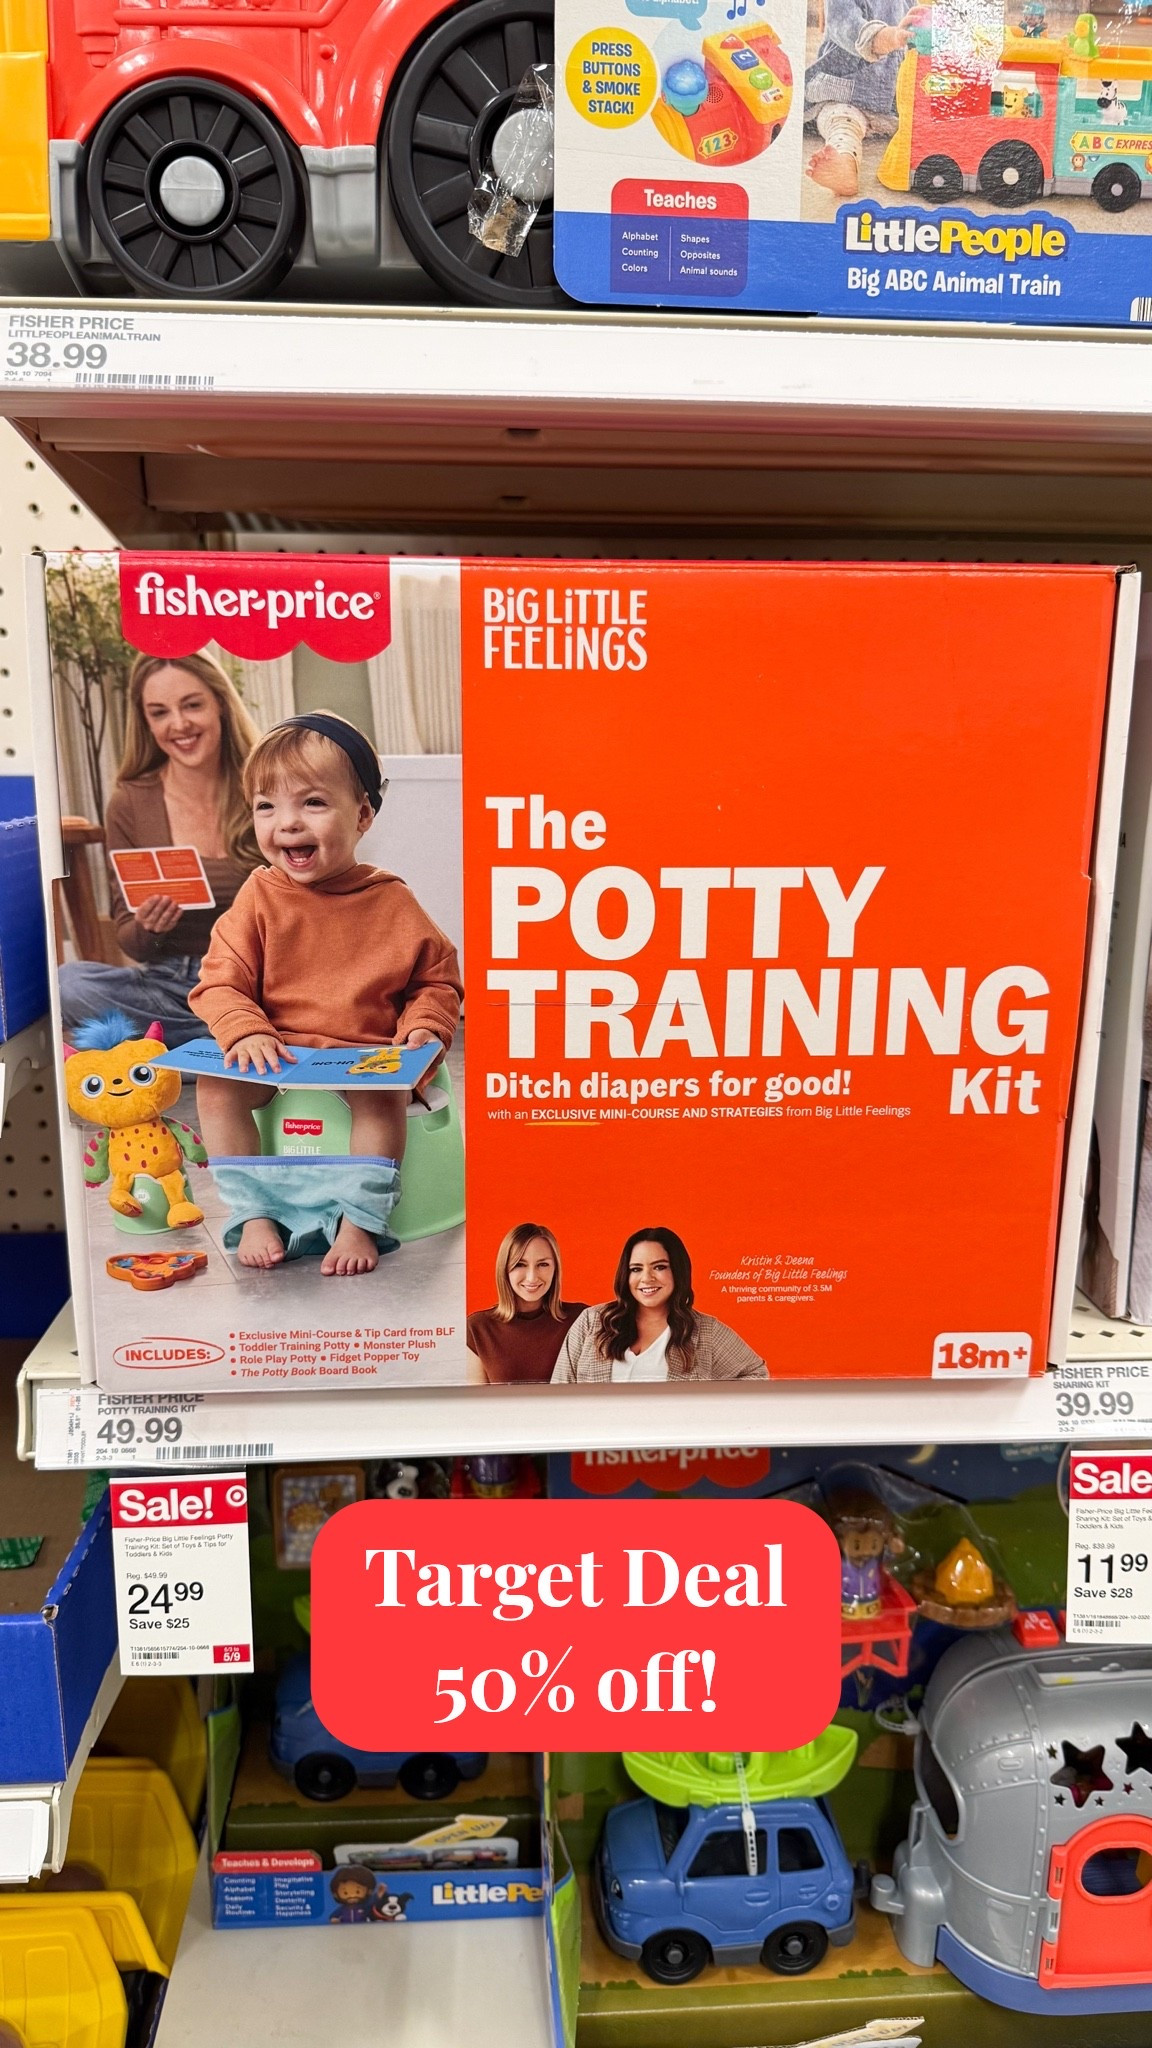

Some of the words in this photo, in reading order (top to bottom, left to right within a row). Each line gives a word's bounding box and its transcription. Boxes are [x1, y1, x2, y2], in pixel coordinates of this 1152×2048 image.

[592, 42, 632, 56] PRESS
[583, 61, 640, 76] BUTTONS
[583, 81, 592, 92] &
[596, 81, 640, 95] SMOKE
[589, 101, 634, 114] STACK!
[644, 189, 717, 209] Teaches
[622, 232, 658, 241] Alphabet
[681, 234, 709, 244] Shapes
[622, 248, 658, 258] Counting
[680, 250, 720, 261] Opposites
[622, 264, 648, 272] Colors
[680, 266, 707, 275] Animal
[710, 267, 737, 276] sounds
[847, 267, 880, 297] Big
[885, 269, 927, 291] ABC
[933, 270, 1003, 294] Animal
[1010, 274, 1061, 296] Train
[9, 315, 74, 329] FISHER
[80, 317, 134, 330] PRICE
[8, 330, 161, 341] LITTLPEOPLEANIMALTRAIN
[7, 342, 107, 369] 38.99
[486, 794, 606, 850] The
[491, 865, 886, 960] POTTY
[486, 965, 1050, 1059] TRAINING
[486, 1072, 570, 1098] Ditch
[580, 1072, 700, 1104] diapers
[709, 1071, 757, 1097] for
[765, 1069, 852, 1102] good!
[949, 1067, 1041, 1115] Kit
[487, 1109, 512, 1119] with
[514, 1111, 528, 1119] an
[532, 1109, 596, 1119] EXCLUSIVE
[600, 1108, 680, 1119] MINI-COURSE
[683, 1107, 708, 1118] AND
[710, 1107, 782, 1118] STRATEGIES
[785, 1106, 812, 1117] from
[815, 1106, 833, 1119] Big
[836, 1105, 862, 1117] Little
[865, 1105, 911, 1118] Feelings
[285, 1122, 320, 1131] fisher-price
[741, 1255, 772, 1265] Kristin
[774, 1255, 782, 1265] &
[785, 1256, 814, 1265] Deena
[709, 1269, 750, 1280] Founders
[753, 1268, 764, 1282] of
[765, 1268, 780, 1283] Big
[782, 1268, 808, 1280] Little
[811, 1268, 848, 1282] Feelings
[729, 1285, 756, 1294] thriving
[758, 1285, 801, 1293] community
[737, 1295, 765, 1303] parents
[775, 1294, 815, 1303] caregivers.
[239, 1330, 287, 1340] Exclusive
[290, 1329, 352, 1339] Mini-Course
[355, 1329, 362, 1338] &
[365, 1328, 378, 1339] Tip
[381, 1328, 407, 1338] Card
[410, 1327, 433, 1337] from
[436, 1327, 455, 1336] BLF
[239, 1342, 277, 1352] Toddler
[280, 1341, 321, 1353] Training
[323, 1340, 350, 1352] Potty
[363, 1340, 404, 1349] Monster
[406, 1339, 436, 1349] Plush
[125, 1348, 211, 1361] INCLUDES:
[240, 1355, 259, 1364] Role
[262, 1355, 287, 1366] Play
[290, 1354, 317, 1365] Potty
[330, 1352, 361, 1363] Fidget
[364, 1352, 399, 1364] Popper
[402, 1352, 419, 1362] Toy
[241, 1368, 260, 1377] The
[262, 1368, 289, 1379] Potty
[291, 1367, 317, 1376] Book
[319, 1366, 349, 1375] Board
[351, 1365, 377, 1374] Book
[1053, 1368, 1102, 1379] FISHER
[1107, 1367, 1149, 1377] PRICE
[1053, 1381, 1093, 1389] SHARING
[99, 1394, 153, 1405] FISHER
[158, 1394, 204, 1403] PRICE
[1056, 1391, 1133, 1417] 39.99
[98, 1407, 130, 1415] POTTY
[132, 1405, 178, 1414] TRAINING
[97, 1417, 182, 1443] 49.99
[119, 1487, 214, 1522] Sale!
[126, 1572, 142, 1580] Reg.
[1074, 1587, 1106, 1598] Save
[1110, 1587, 1133, 1598] $28
[129, 1619, 162, 1629] Save
[166, 1618, 190, 1629] $25
[223, 1653, 240, 1661] 5/9
[222, 1858, 260, 1867] Teaches
[262, 1858, 269, 1867] &
[271, 1858, 314, 1867] Develops
